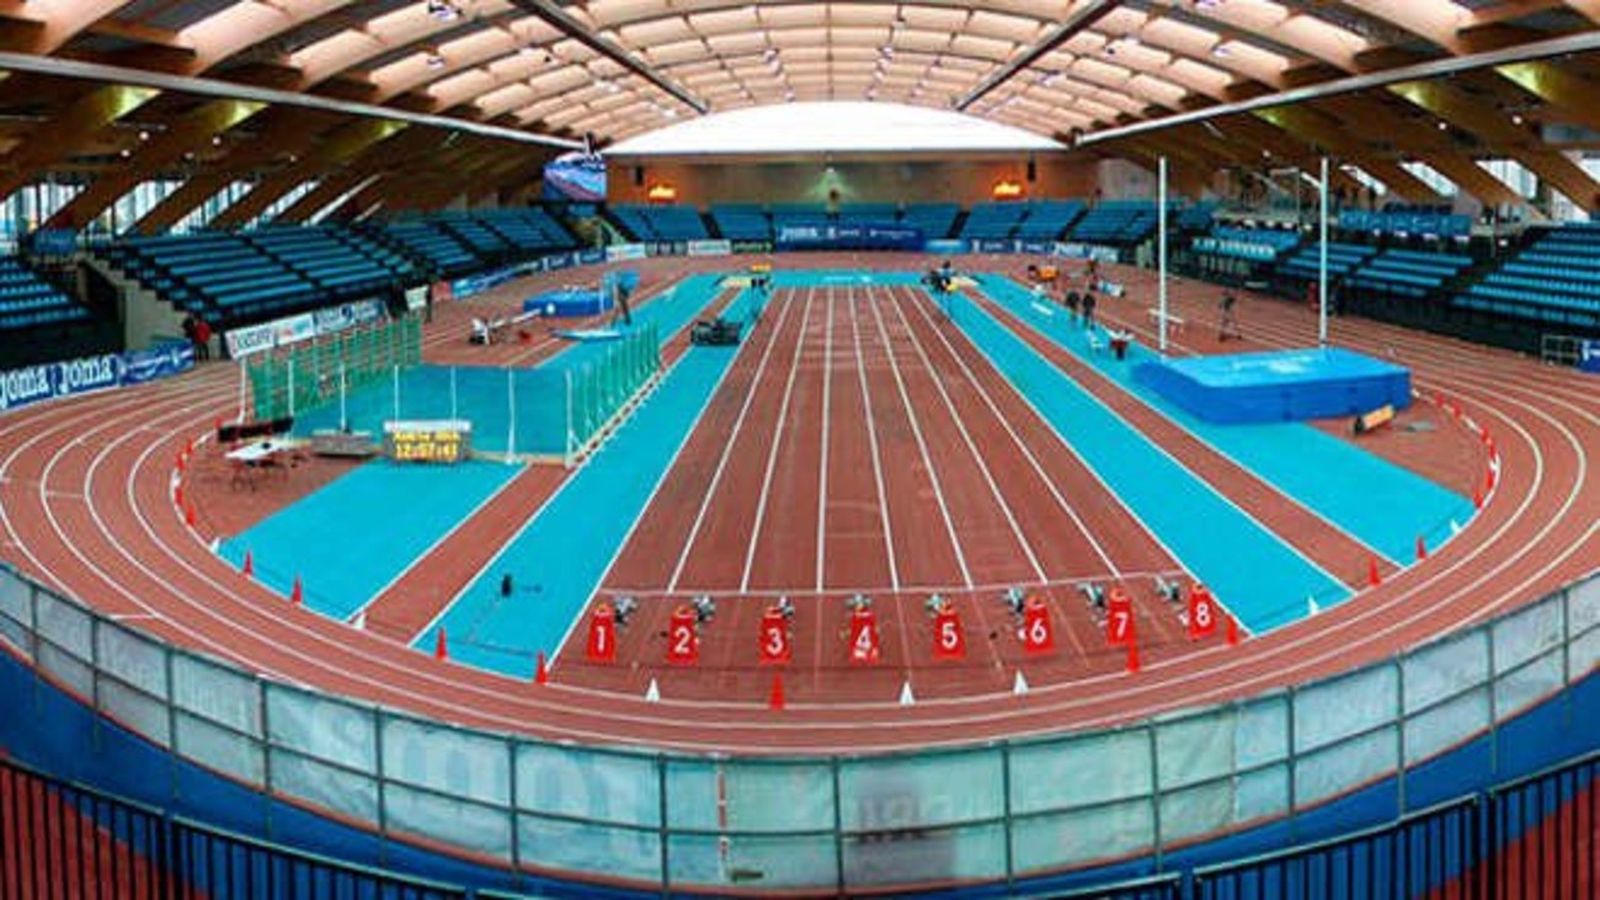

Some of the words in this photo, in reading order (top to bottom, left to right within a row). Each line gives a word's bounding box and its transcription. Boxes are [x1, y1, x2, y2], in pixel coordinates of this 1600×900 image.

[60, 353, 114, 394] Joma
[1114, 611, 1129, 638] 7
[1196, 602, 1211, 627] 8
[596, 625, 605, 653] 1
[673, 626, 691, 653] 2
[766, 627, 784, 655] 3
[855, 625, 872, 651] 4
[942, 622, 958, 649] 5
[1030, 618, 1047, 644] 6
